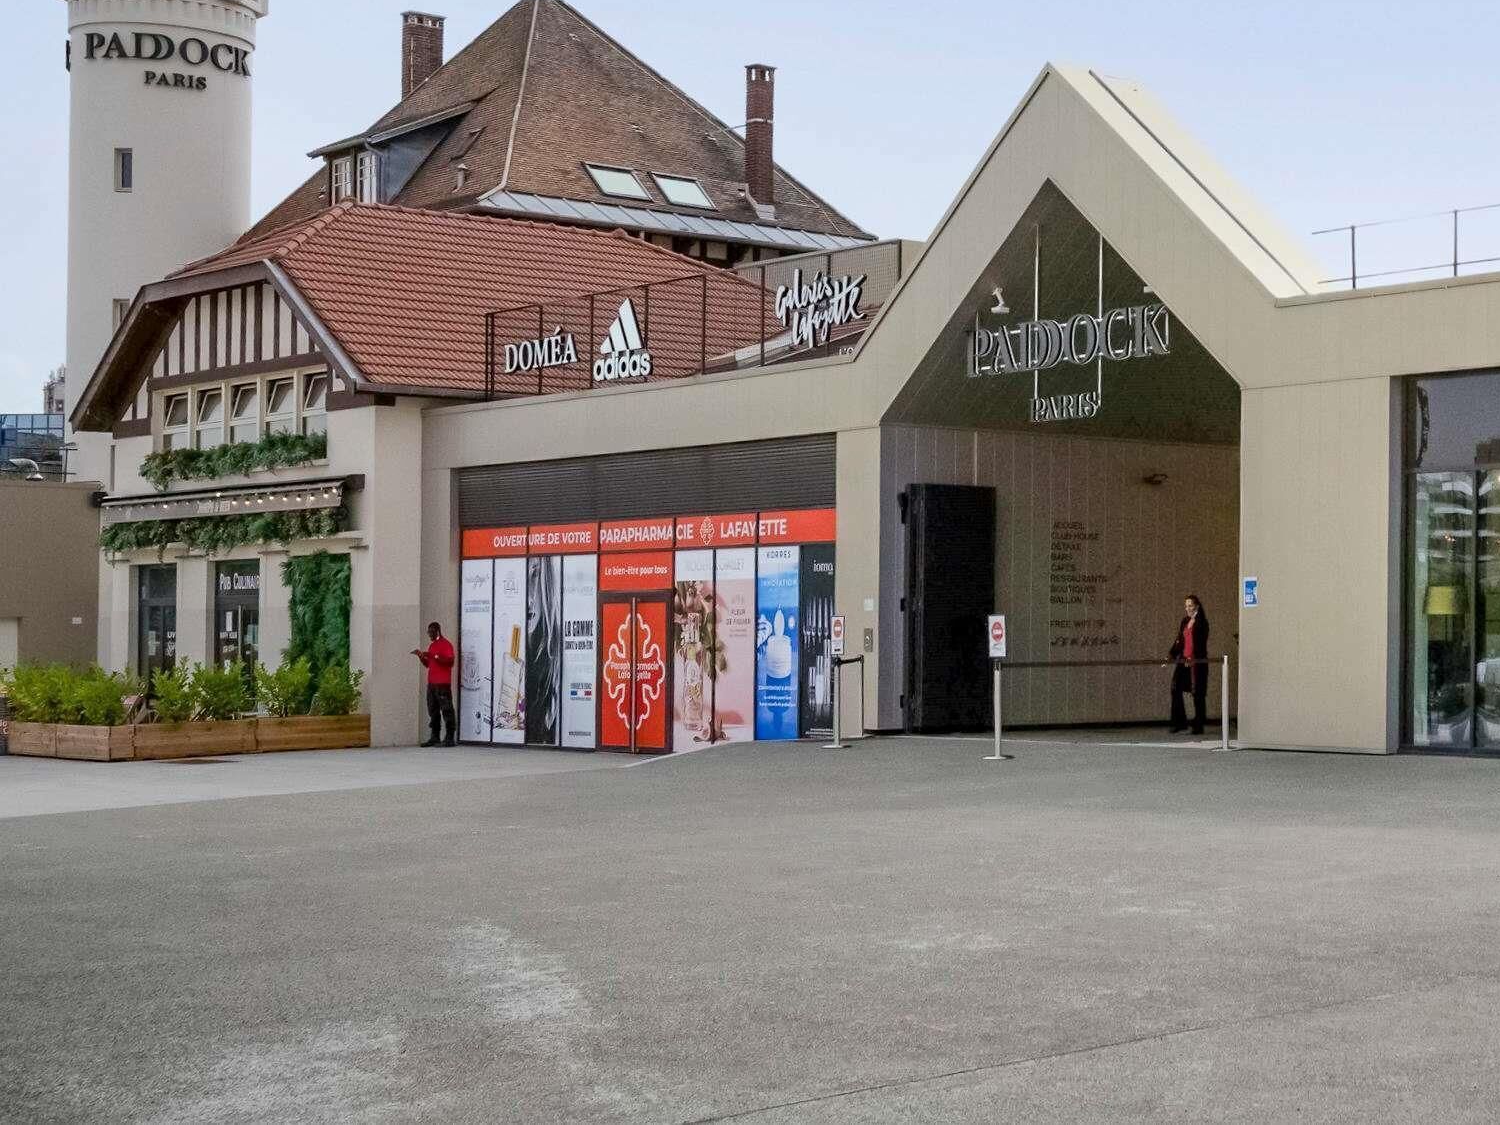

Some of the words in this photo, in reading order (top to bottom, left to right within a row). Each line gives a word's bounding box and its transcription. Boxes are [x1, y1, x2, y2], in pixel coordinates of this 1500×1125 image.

[84, 32, 252, 77] PADDOCK
[144, 70, 208, 91] PARIS
[504, 325, 579, 374] DOMÉA
[967, 303, 1171, 377] PADDOCK
[593, 348, 653, 382] adidas
[1031, 391, 1099, 422] PARIS
[493, 533, 546, 548] OUVERTURE
[547, 533, 560, 545] DE
[561, 531, 592, 545] VOTRE
[600, 523, 694, 544] PARAPHARMACIE
[720, 518, 788, 539] LAFAYETTE
